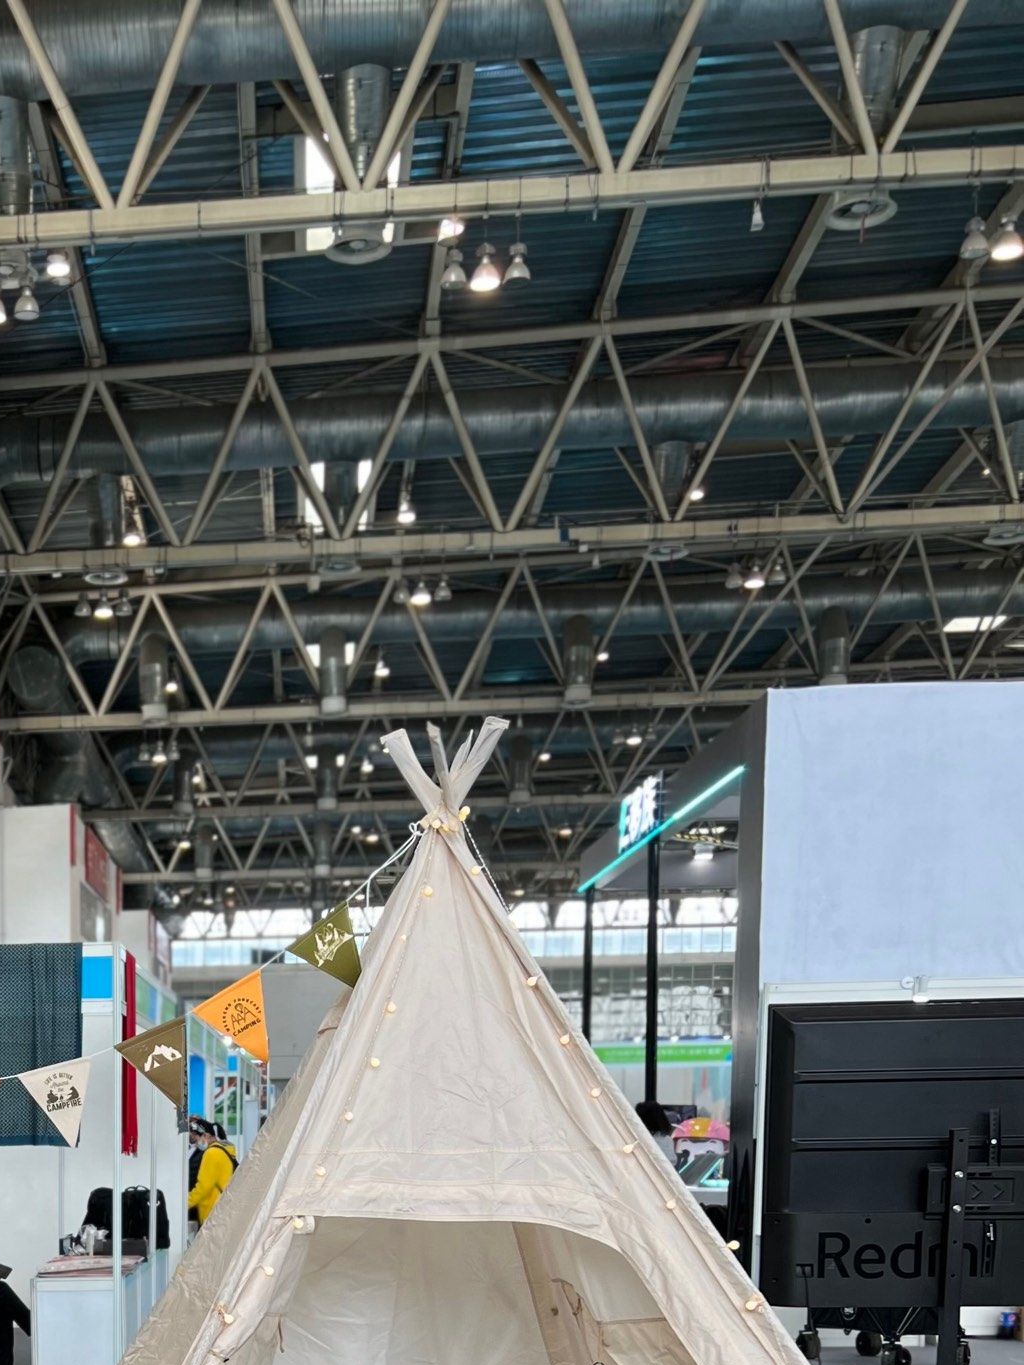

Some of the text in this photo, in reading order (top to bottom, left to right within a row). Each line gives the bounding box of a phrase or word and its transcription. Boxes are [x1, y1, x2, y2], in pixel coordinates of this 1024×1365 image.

[232, 1017, 262, 1037] CAMPING
[46, 1097, 82, 1112] CAMPFIRE
[816, 1231, 977, 1279] Redm
